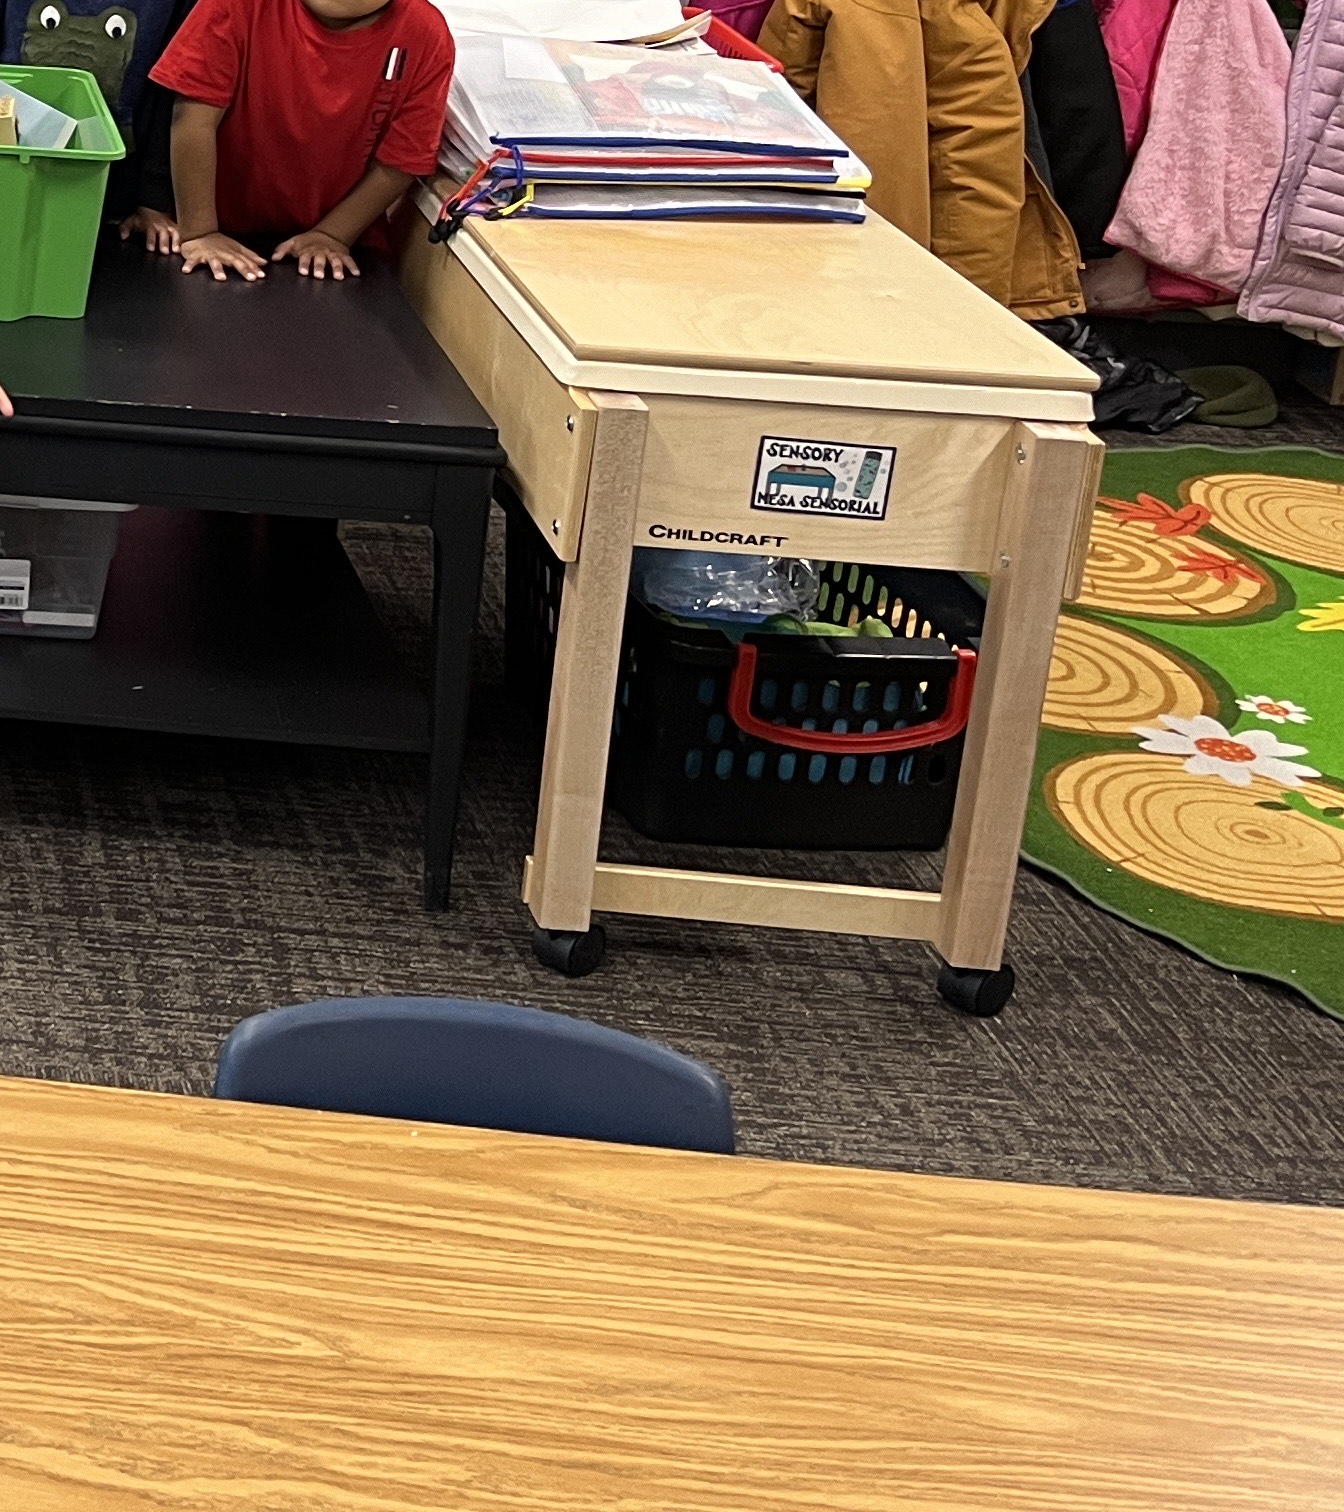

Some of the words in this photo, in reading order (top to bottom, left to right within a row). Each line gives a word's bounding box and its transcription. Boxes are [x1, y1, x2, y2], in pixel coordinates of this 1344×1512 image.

[766, 442, 844, 463] SENSORY
[757, 491, 796, 508] MESA
[799, 495, 880, 515] SENSORIAL
